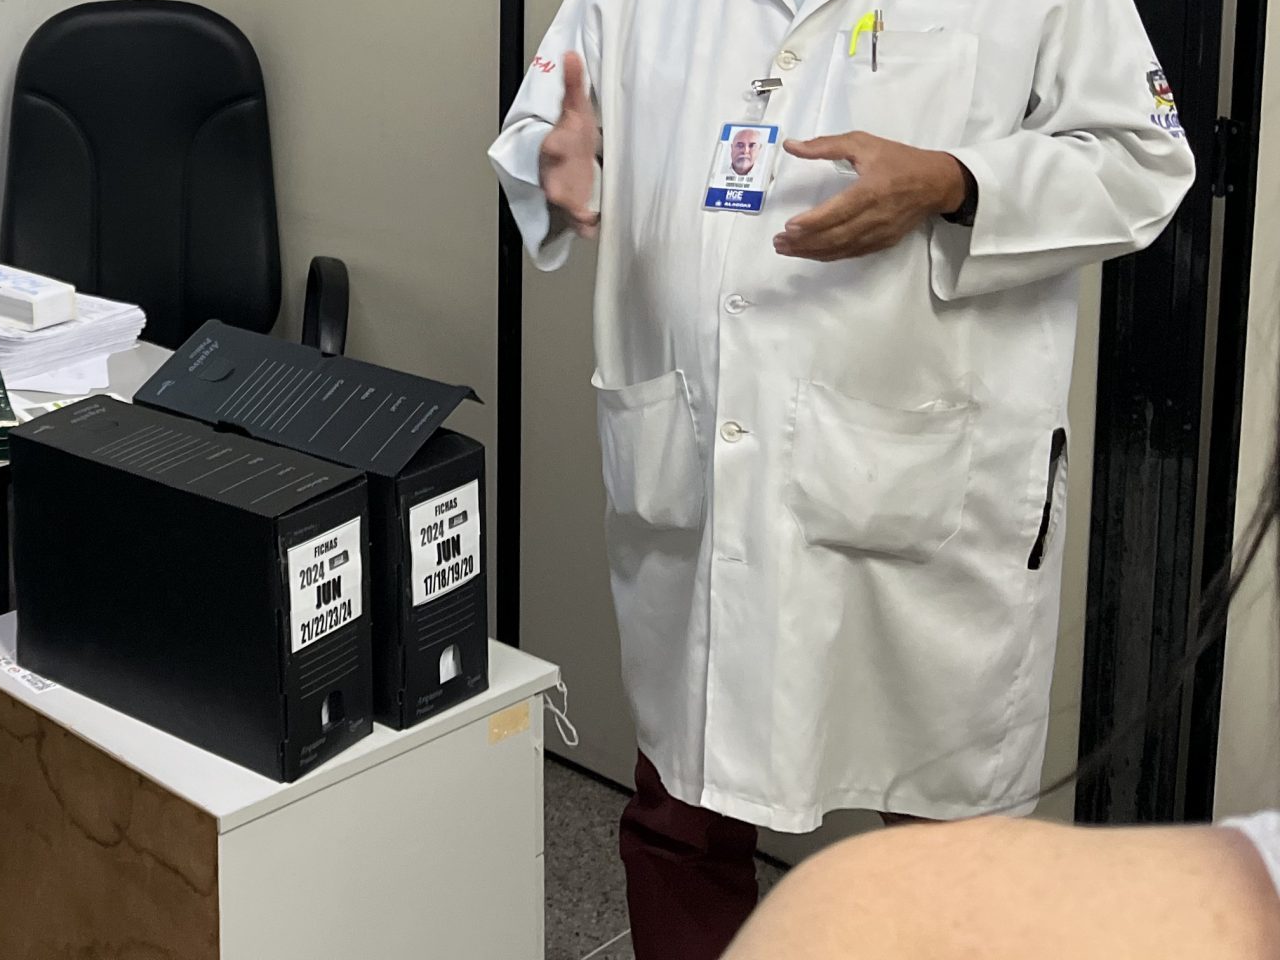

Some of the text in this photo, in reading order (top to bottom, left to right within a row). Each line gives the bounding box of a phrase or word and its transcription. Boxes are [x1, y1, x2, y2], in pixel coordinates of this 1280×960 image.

[434, 497, 458, 517] FICHAS
[314, 537, 338, 559] FICHAS
[420, 520, 444, 547] 2024
[436, 533, 461, 567] JUN
[299, 560, 325, 590] 2024
[423, 554, 474, 596] 17/18/19/20
[315, 574, 342, 610] JUN
[300, 598, 352, 644] 21/22/23/24
